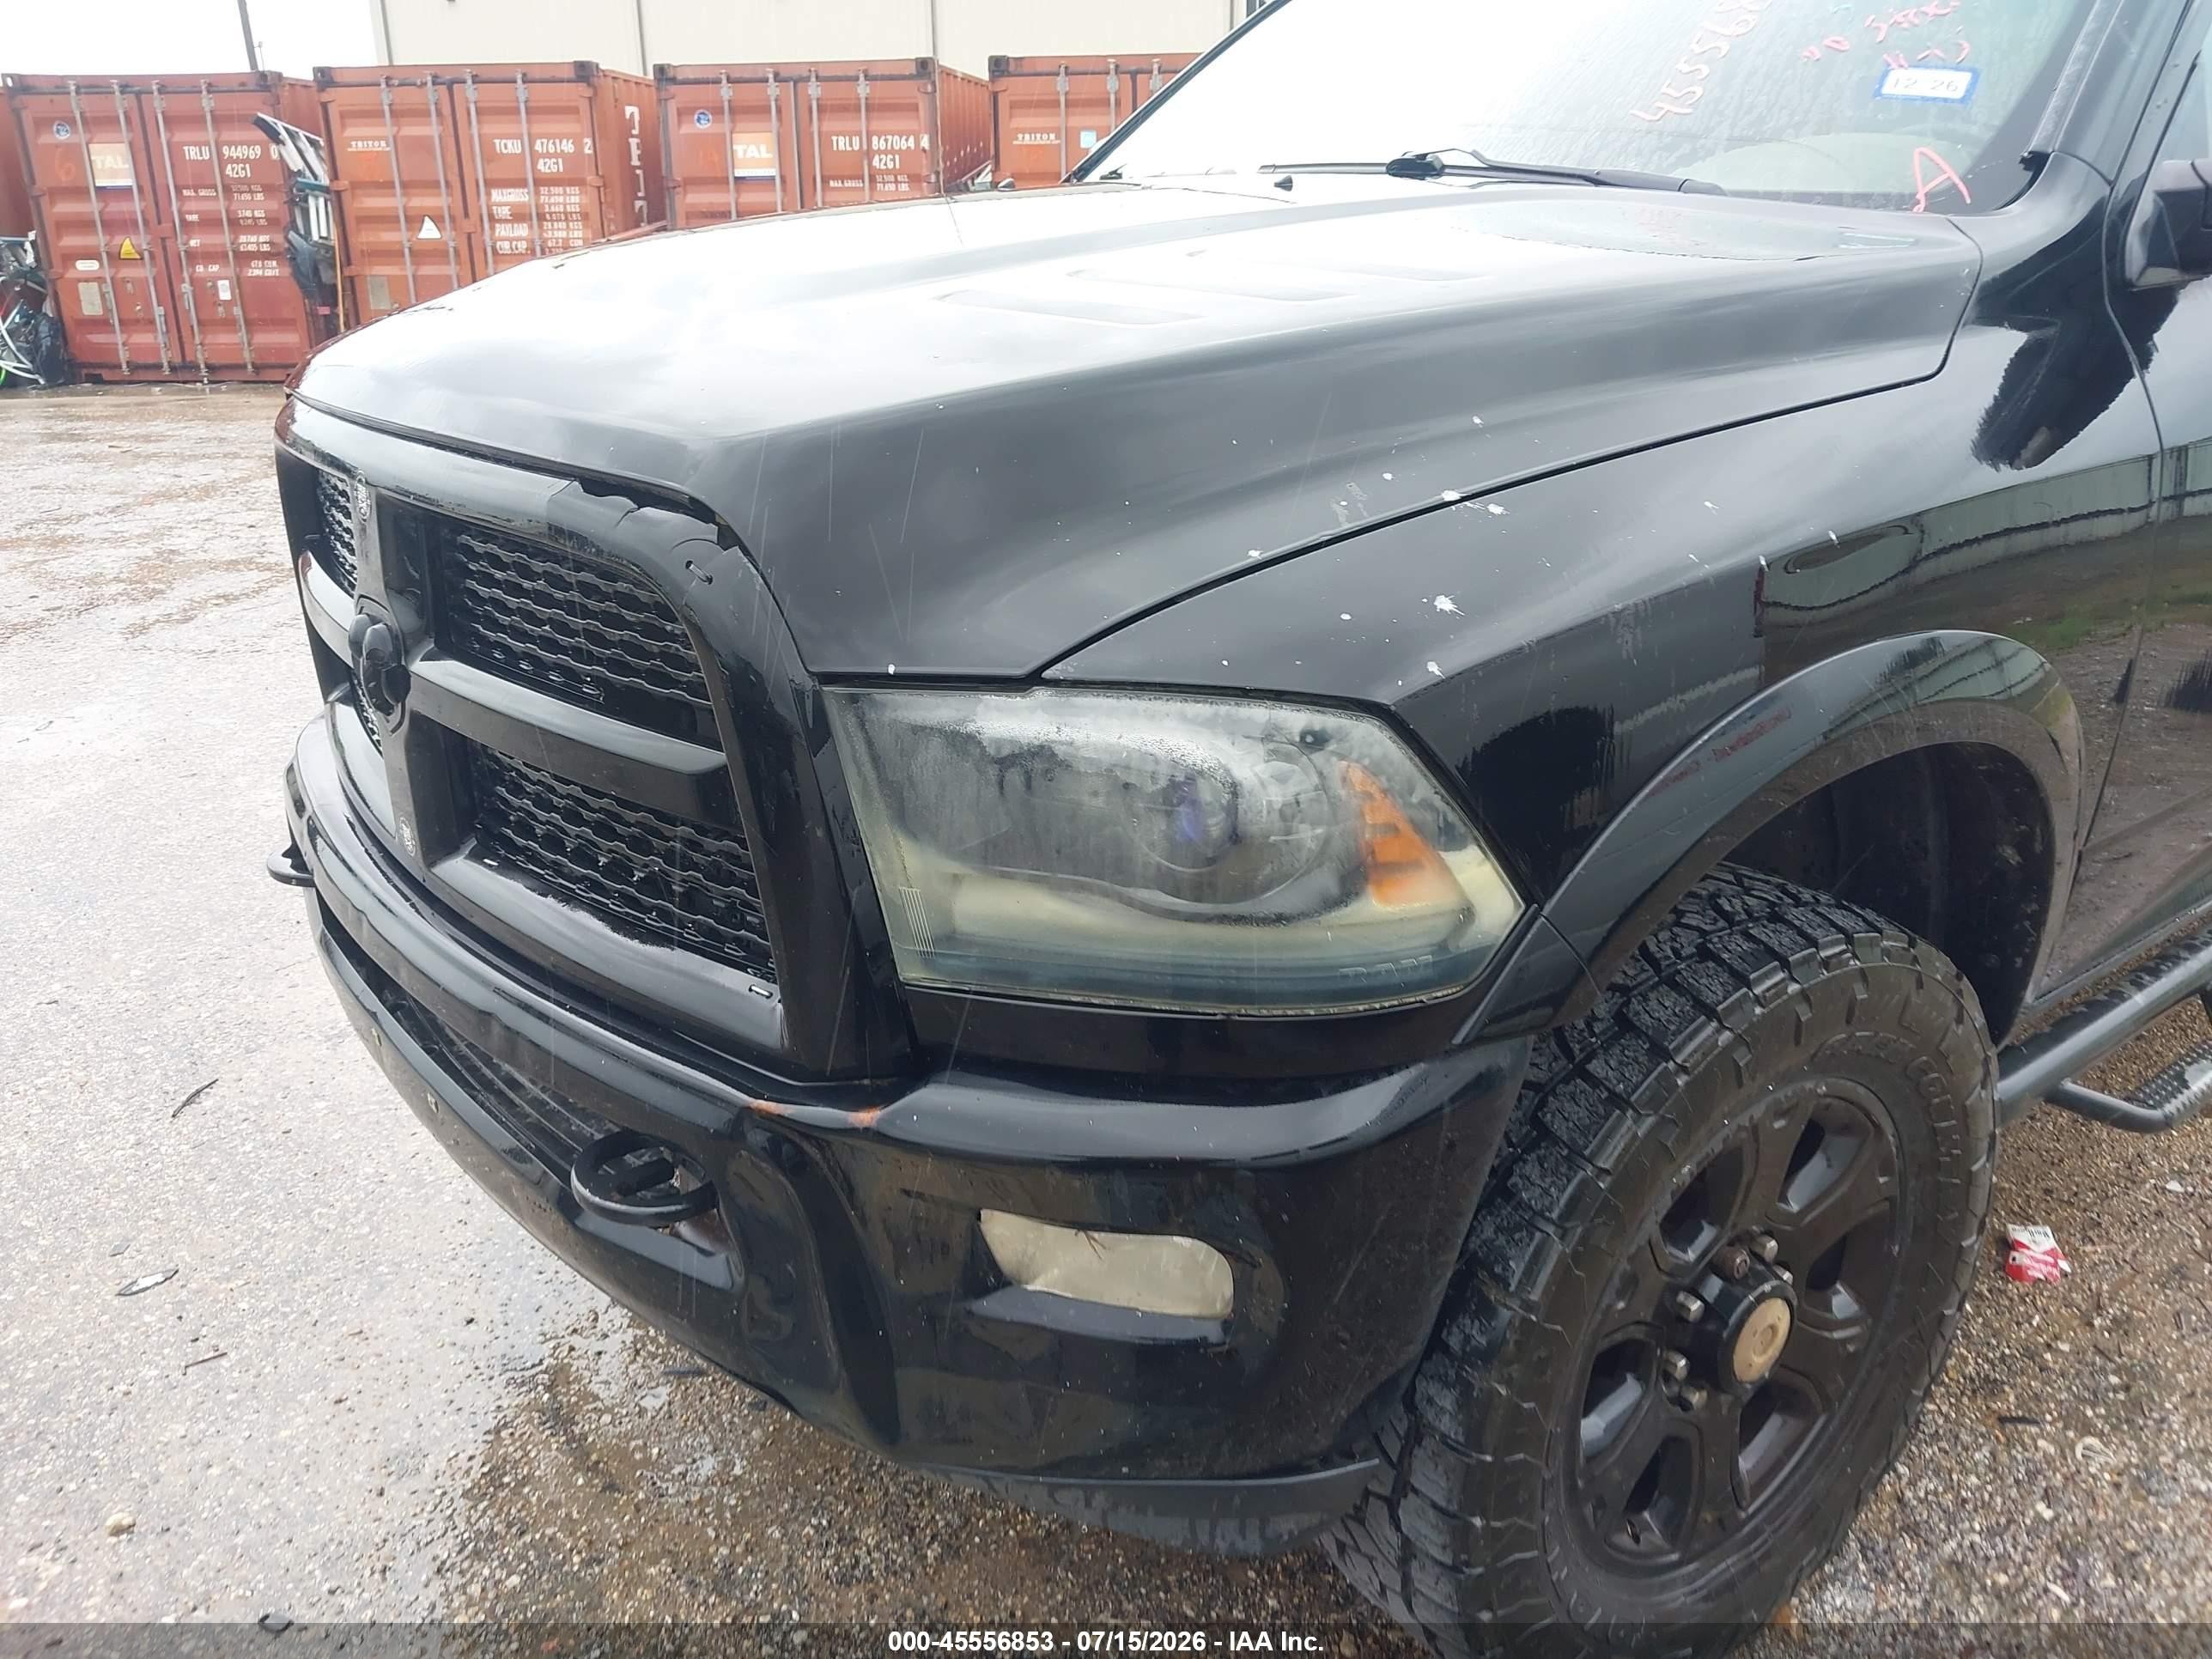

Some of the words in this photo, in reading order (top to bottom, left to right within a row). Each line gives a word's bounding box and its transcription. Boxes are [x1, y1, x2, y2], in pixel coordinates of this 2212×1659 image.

[493, 139, 523, 155] TCKU
[534, 138, 575, 154] 476146
[583, 138, 593, 154] 2
[830, 135, 860, 151] TRLU
[872, 134, 915, 151] 867064
[921, 134, 930, 151] 4
[183, 145, 210, 161] TRLU
[222, 144, 262, 161] 944969
[732, 143, 774, 159] TAL
[92, 154, 130, 169] TAL
[537, 158, 564, 173] 42G1
[872, 154, 901, 170] 42G1
[226, 163, 252, 179] 42G1
[1911, 147, 1972, 213] A
